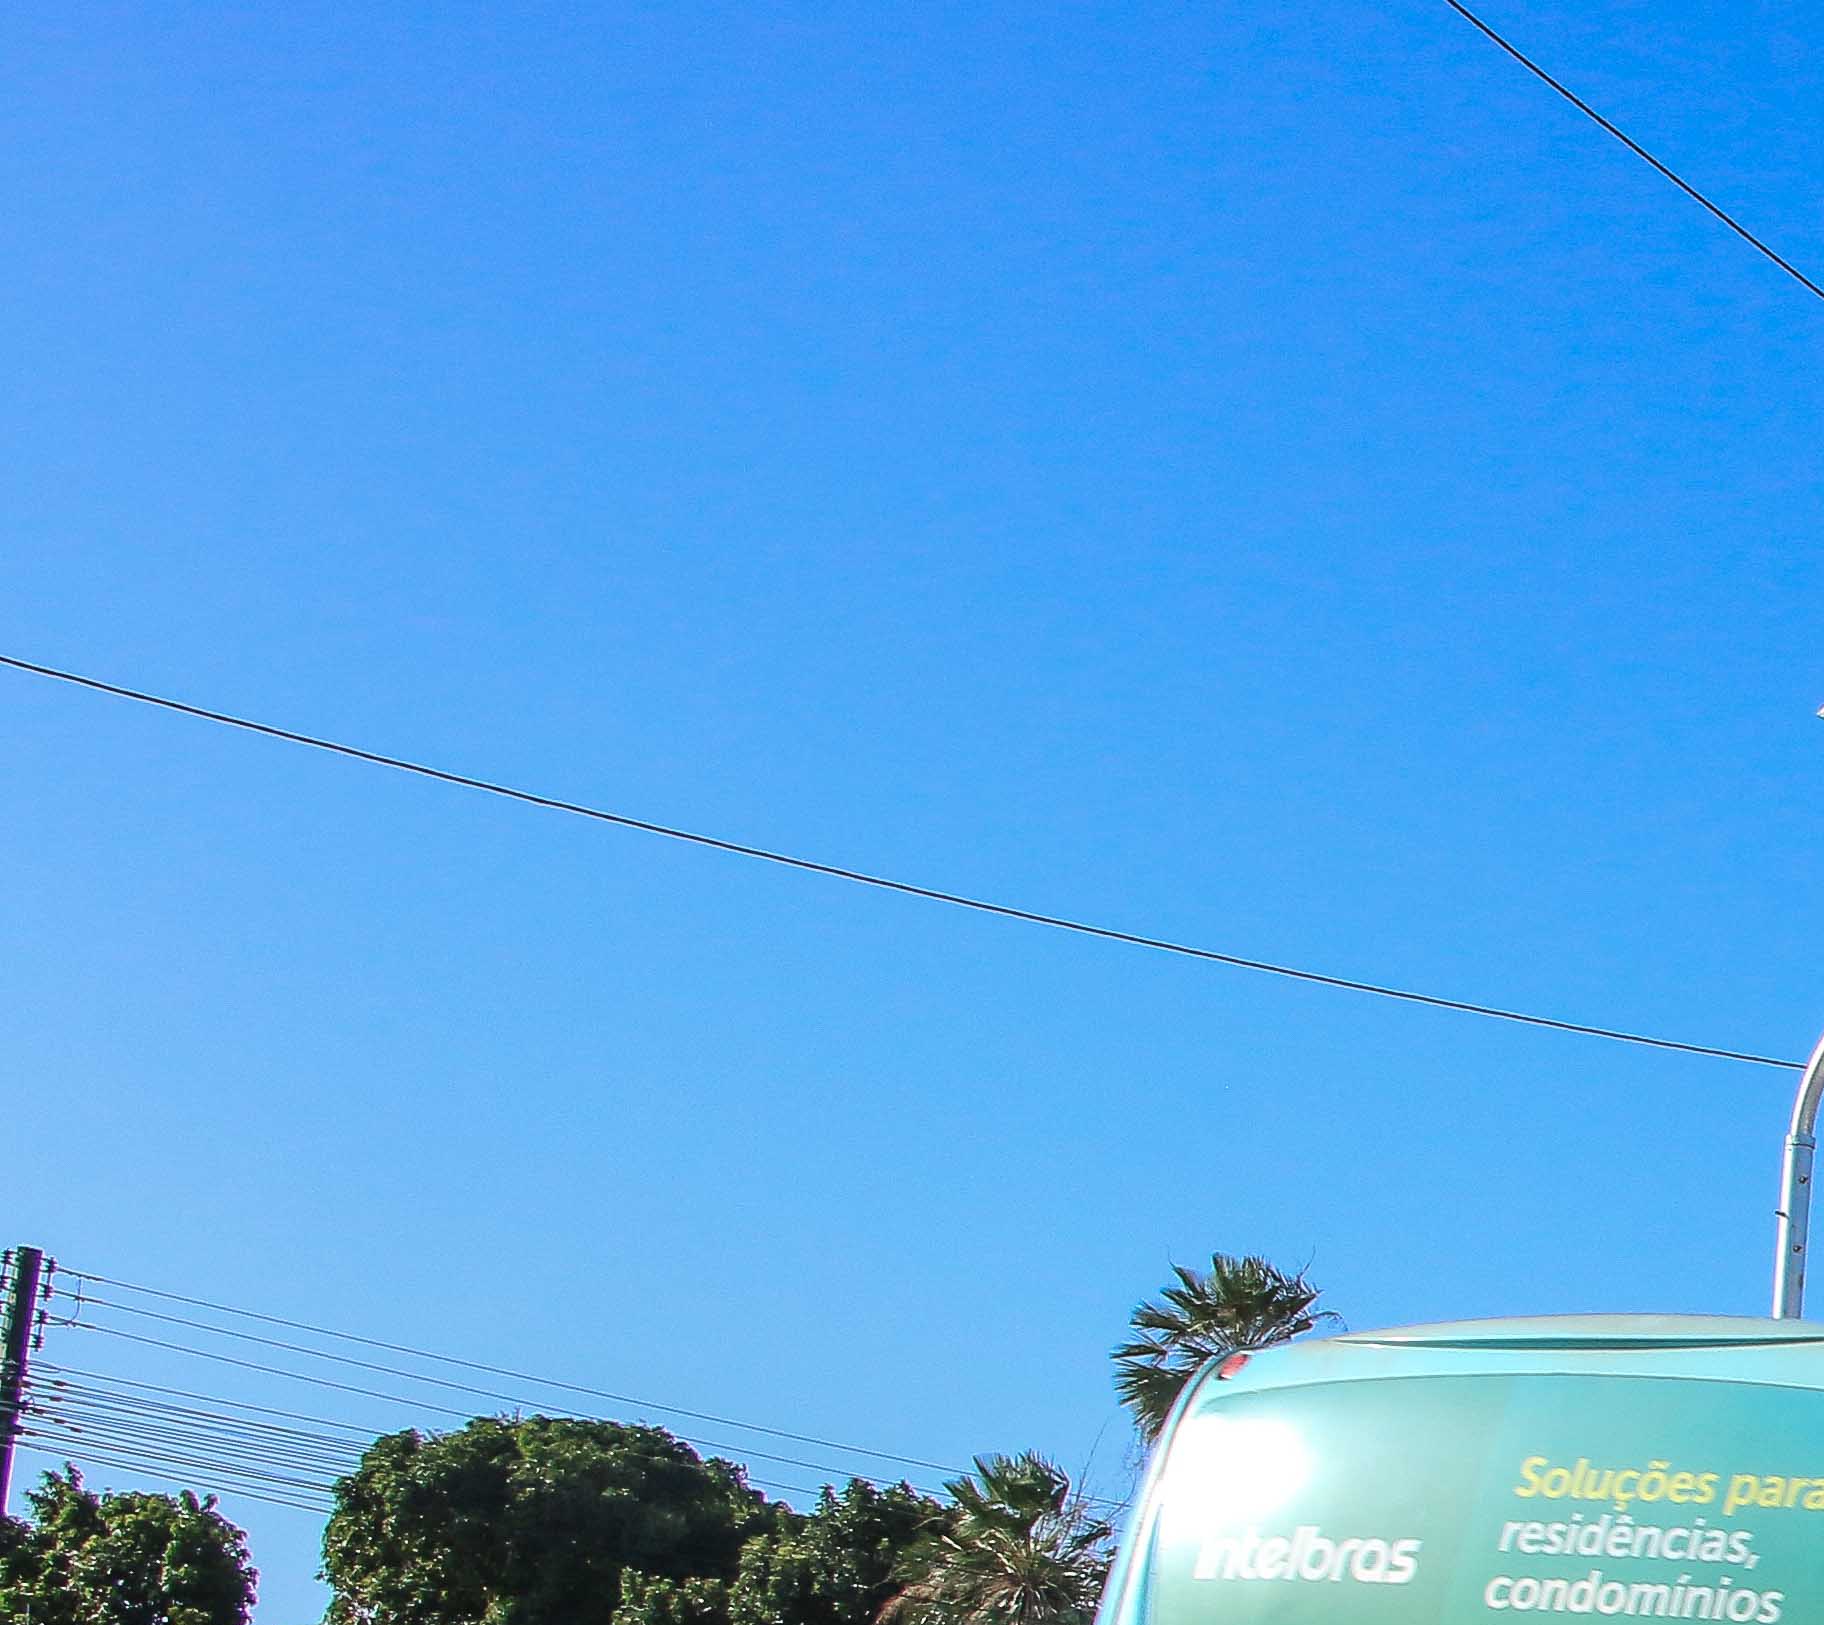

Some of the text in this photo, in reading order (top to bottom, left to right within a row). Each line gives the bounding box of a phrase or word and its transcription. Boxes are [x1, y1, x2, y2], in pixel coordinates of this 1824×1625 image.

[1514, 1455, 1721, 1512] Soluções
[1497, 1513, 1761, 1569] residências,
[1484, 1569, 1786, 1625] condomínios
